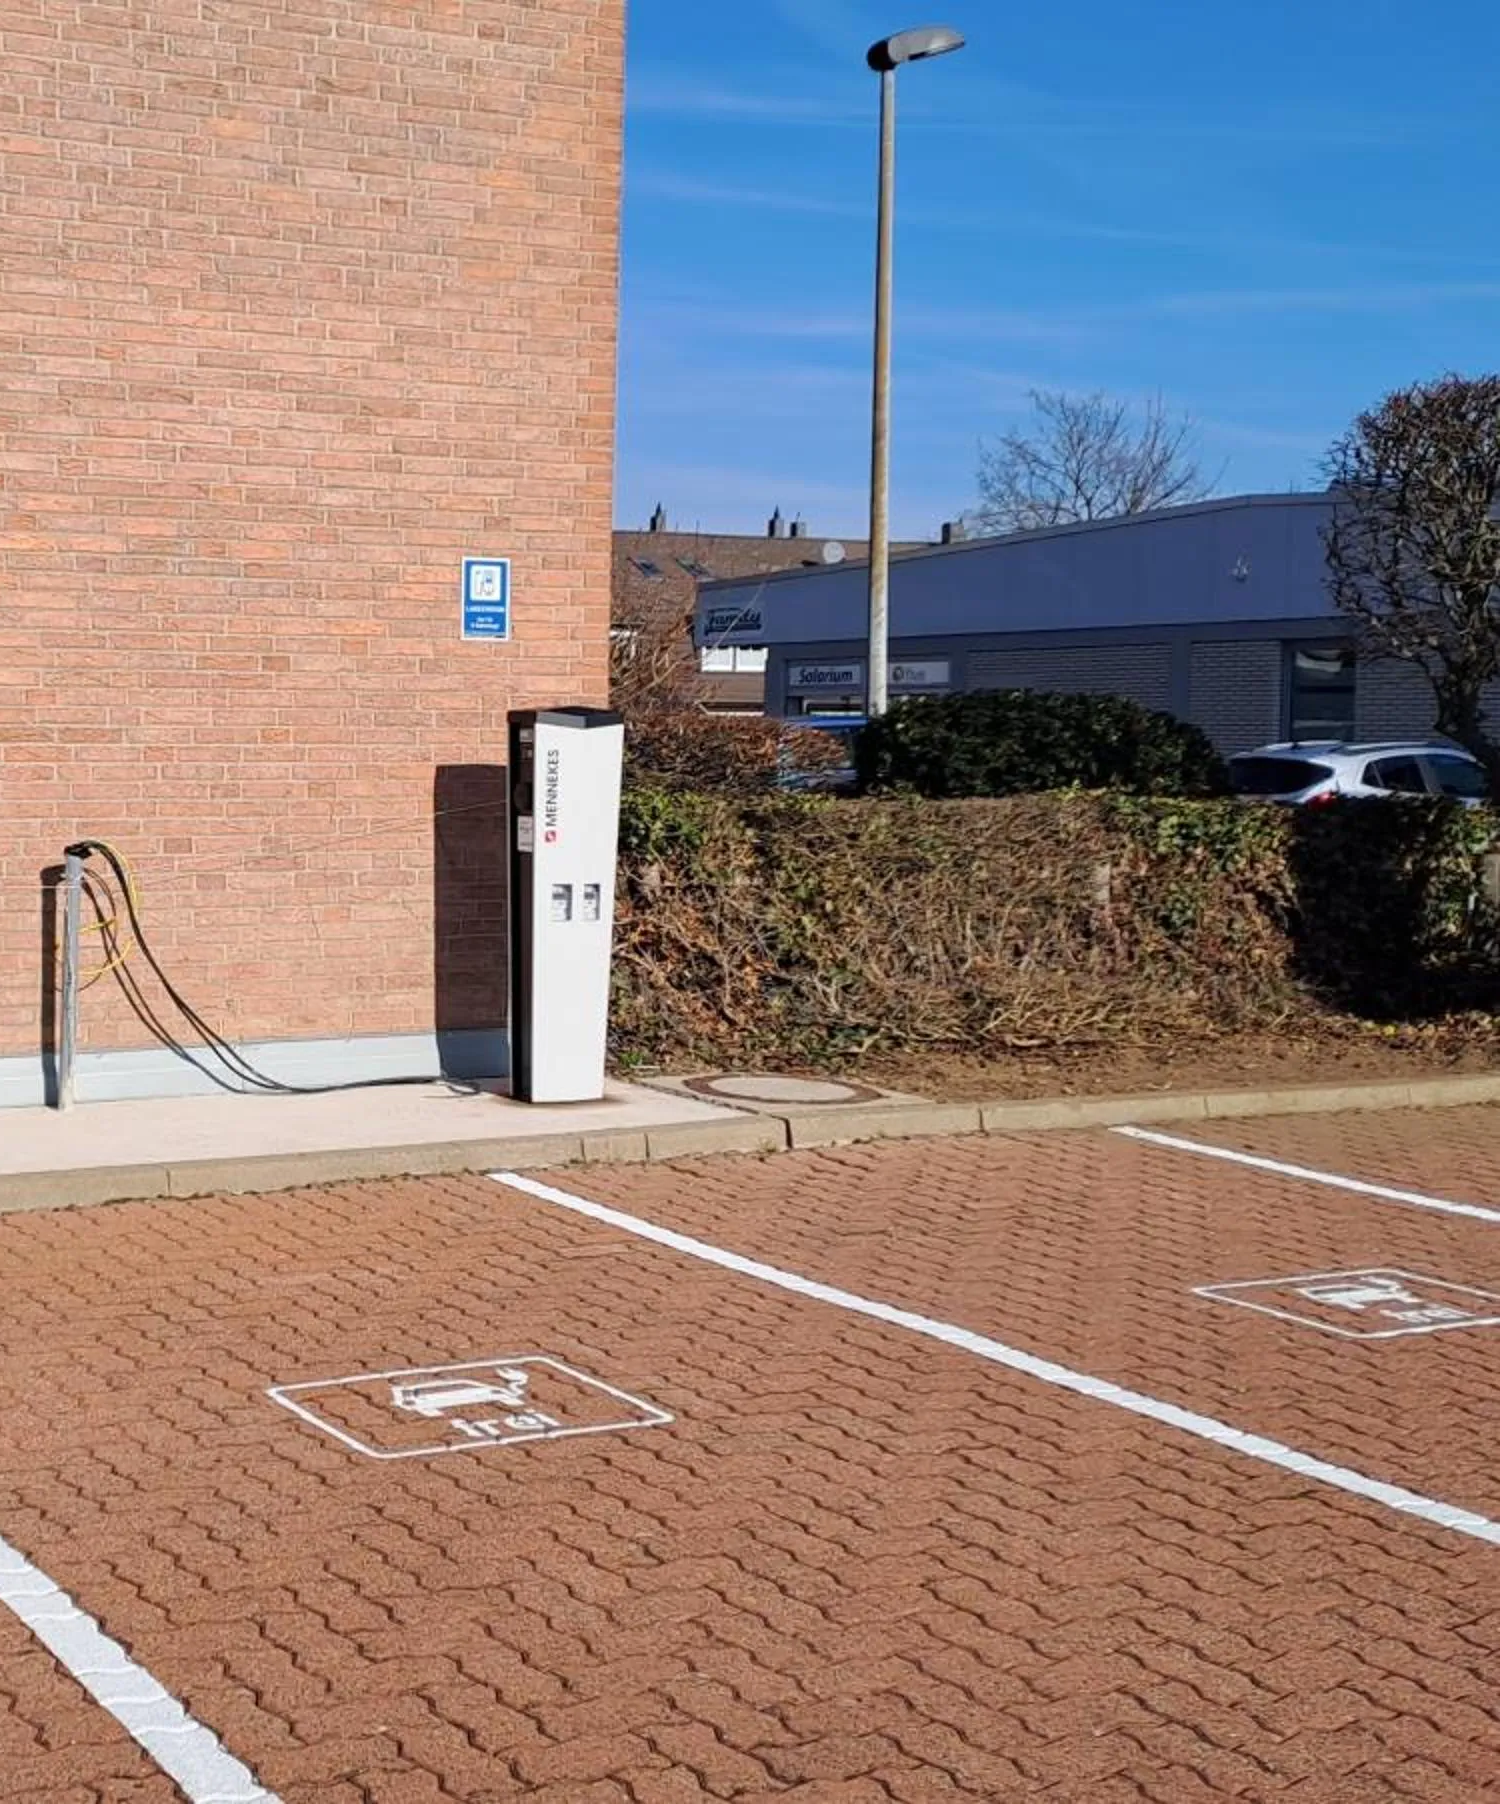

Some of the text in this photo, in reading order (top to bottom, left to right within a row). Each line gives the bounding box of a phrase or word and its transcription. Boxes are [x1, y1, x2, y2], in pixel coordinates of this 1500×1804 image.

[799, 666, 853, 684] Solarium
[545, 749, 559, 827] MENNEKES
[451, 1409, 560, 1437] frei
